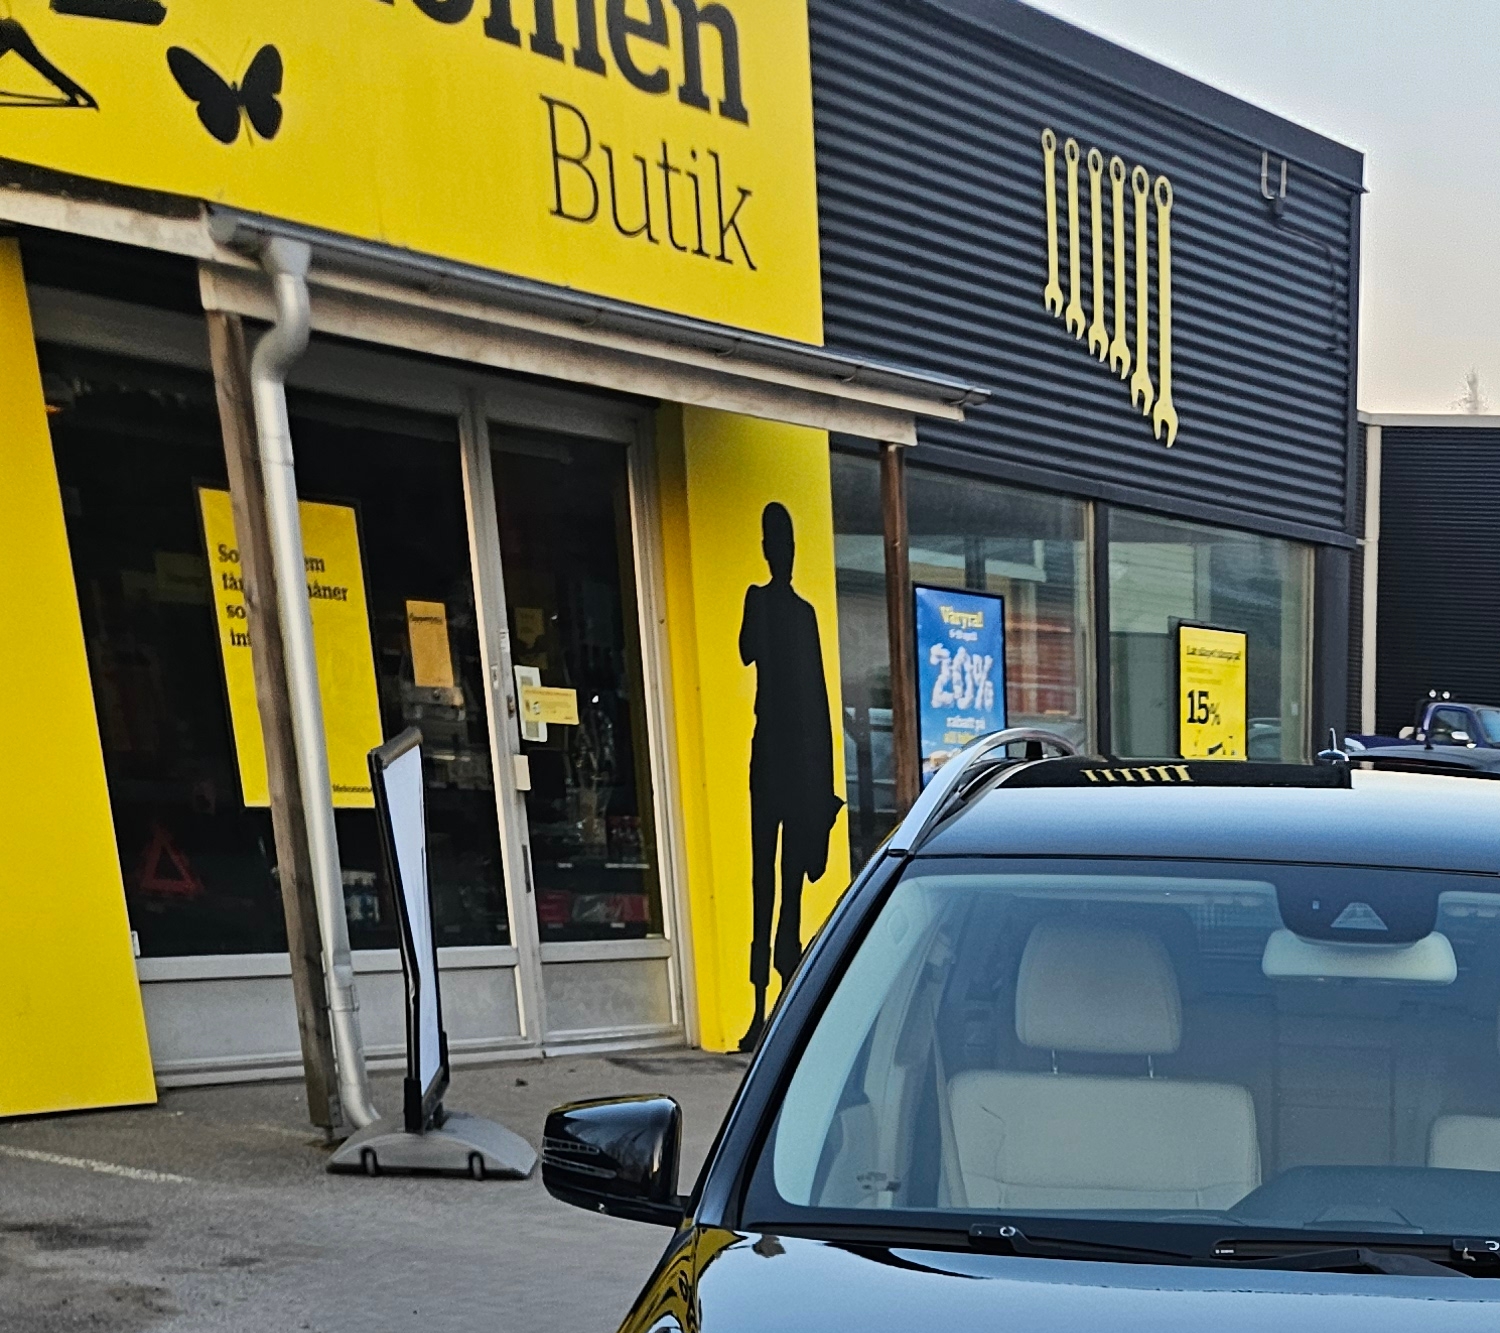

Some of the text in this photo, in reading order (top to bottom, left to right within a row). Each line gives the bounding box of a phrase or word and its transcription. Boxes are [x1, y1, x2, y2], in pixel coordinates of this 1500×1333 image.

[539, 92, 758, 271] Butik
[929, 642, 995, 712] 20%
[1186, 689, 1221, 726] 15%
